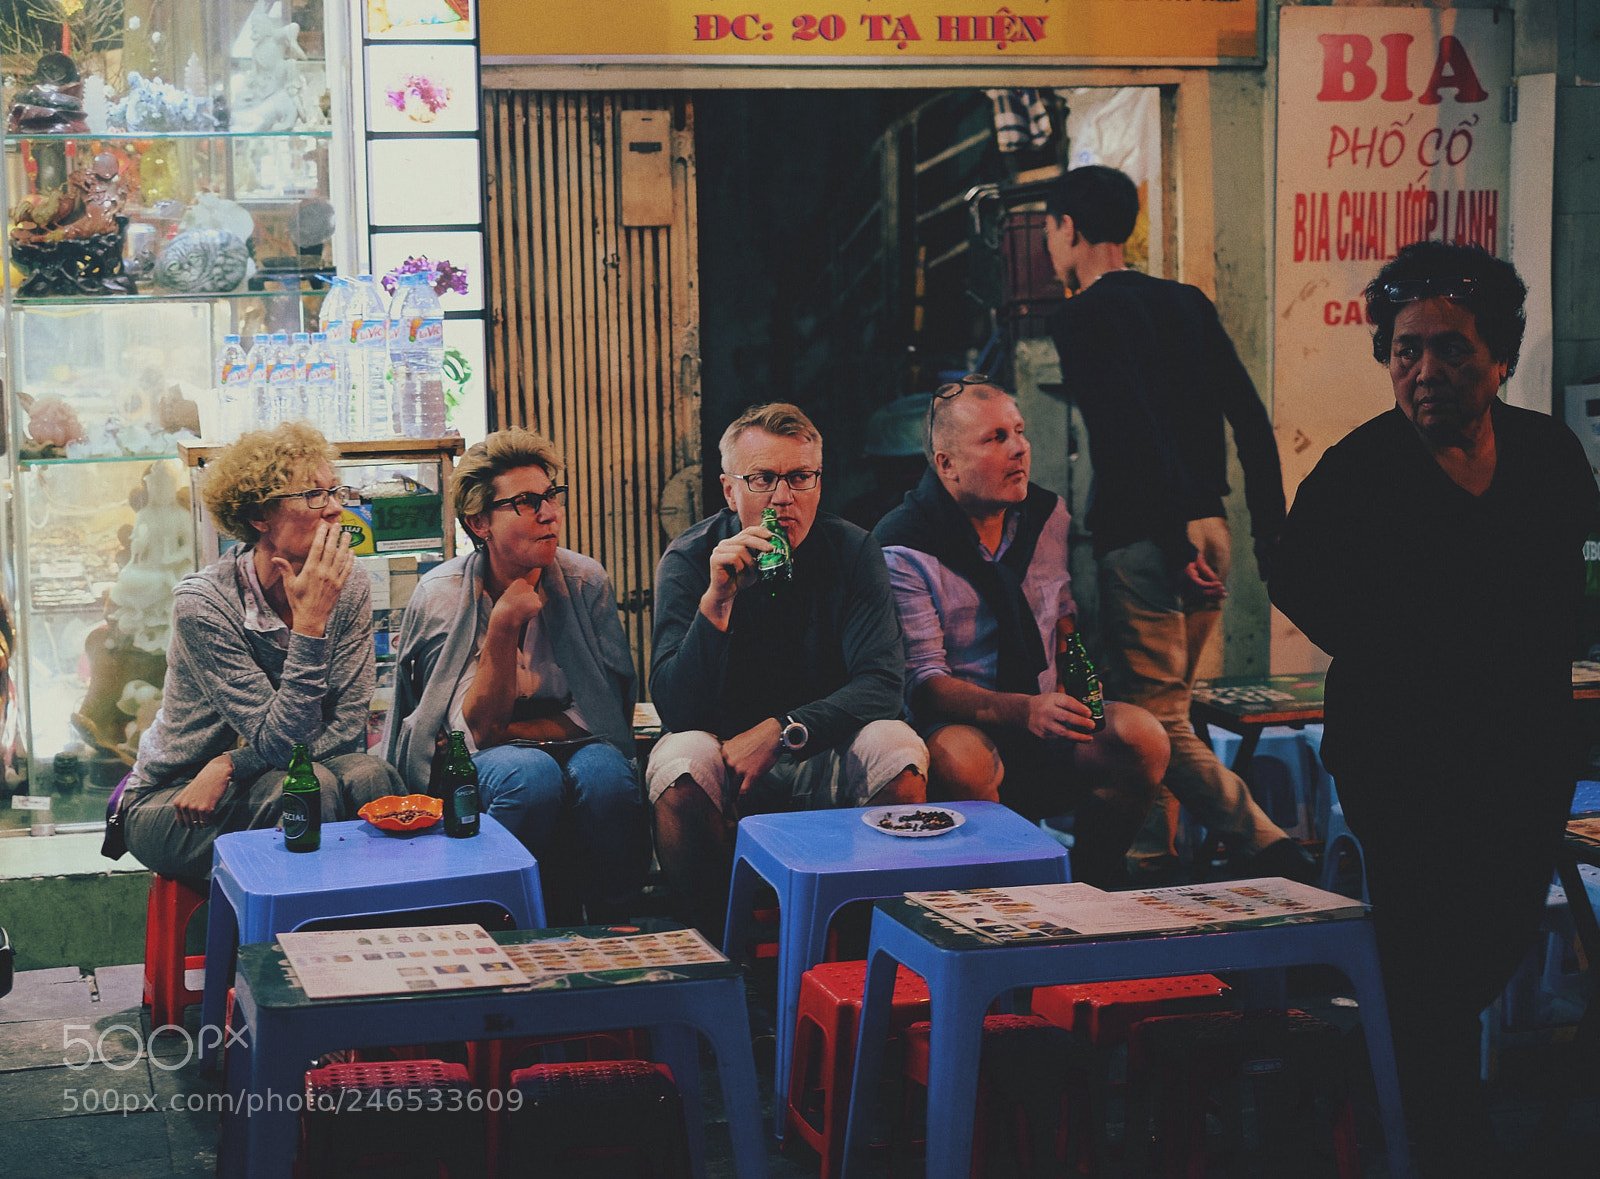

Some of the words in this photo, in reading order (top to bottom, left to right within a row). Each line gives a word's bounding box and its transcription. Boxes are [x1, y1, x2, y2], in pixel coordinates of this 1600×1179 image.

[693, 13, 773, 42] ĐC:
[792, 13, 846, 42] 20
[860, 13, 922, 50] TẠ
[936, 6, 1049, 50] HIỆN
[1316, 33, 1489, 105] BIA
[1327, 113, 1414, 169] PHỐ
[1417, 113, 1480, 167] CỔ
[1293, 192, 1331, 263] BIA
